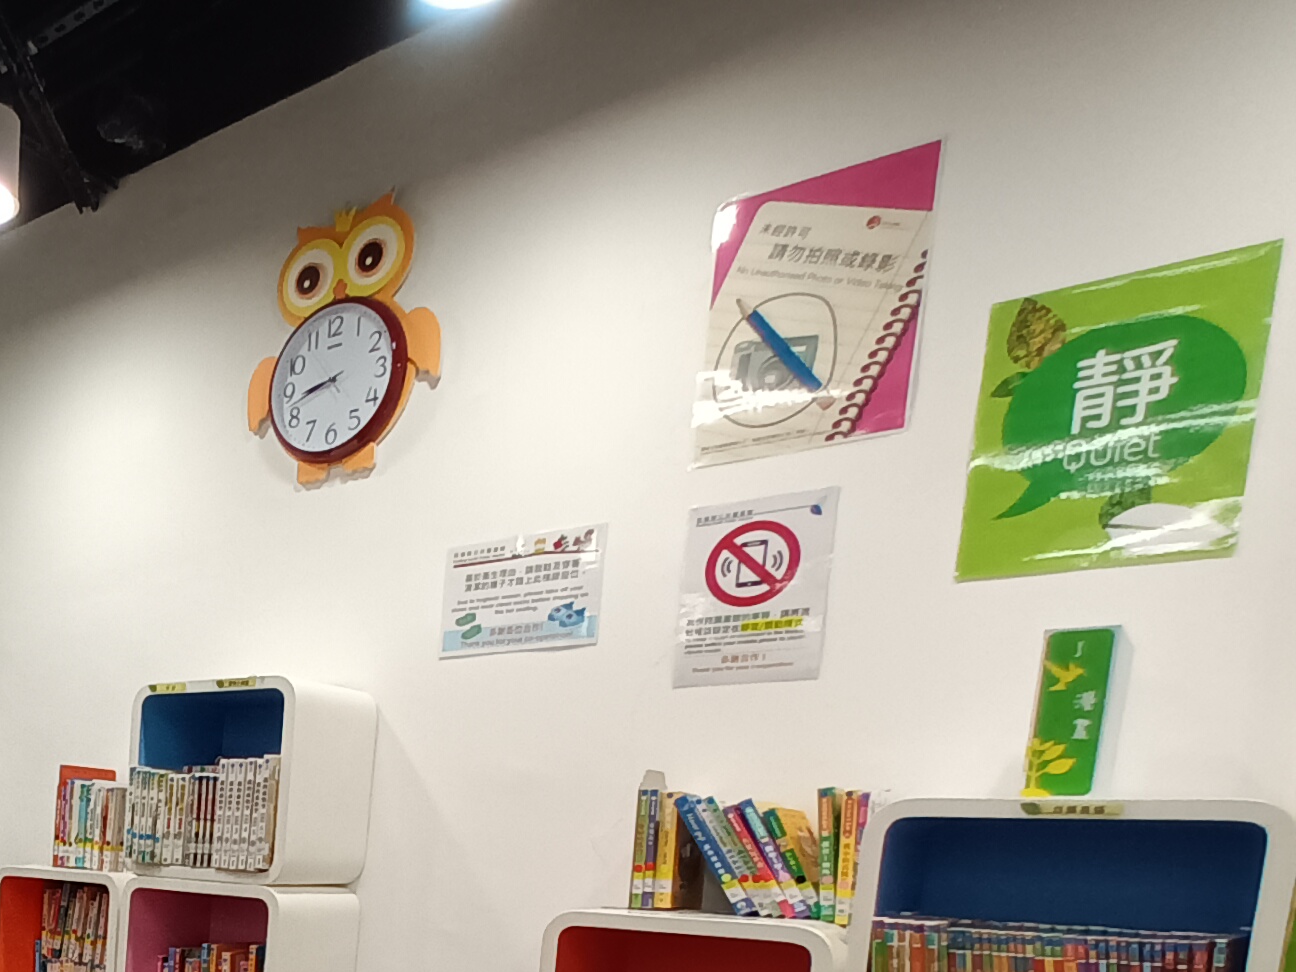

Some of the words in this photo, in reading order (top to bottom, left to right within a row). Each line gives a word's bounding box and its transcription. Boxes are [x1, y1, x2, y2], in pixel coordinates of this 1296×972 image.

[768, 243, 900, 274] 請勿拍照或錄影
[328, 315, 344, 338] 12
[307, 330, 319, 352] 11
[369, 331, 382, 353] 2
[289, 355, 306, 376] 10
[375, 357, 387, 378] 3
[283, 382, 295, 402] 9
[365, 387, 379, 406] 4
[1071, 338, 1180, 434] 靜
[288, 406, 300, 428] 8
[348, 409, 361, 431] 5
[305, 420, 317, 442] 7
[325, 423, 337, 445] 6
[1074, 640, 1085, 658] J
